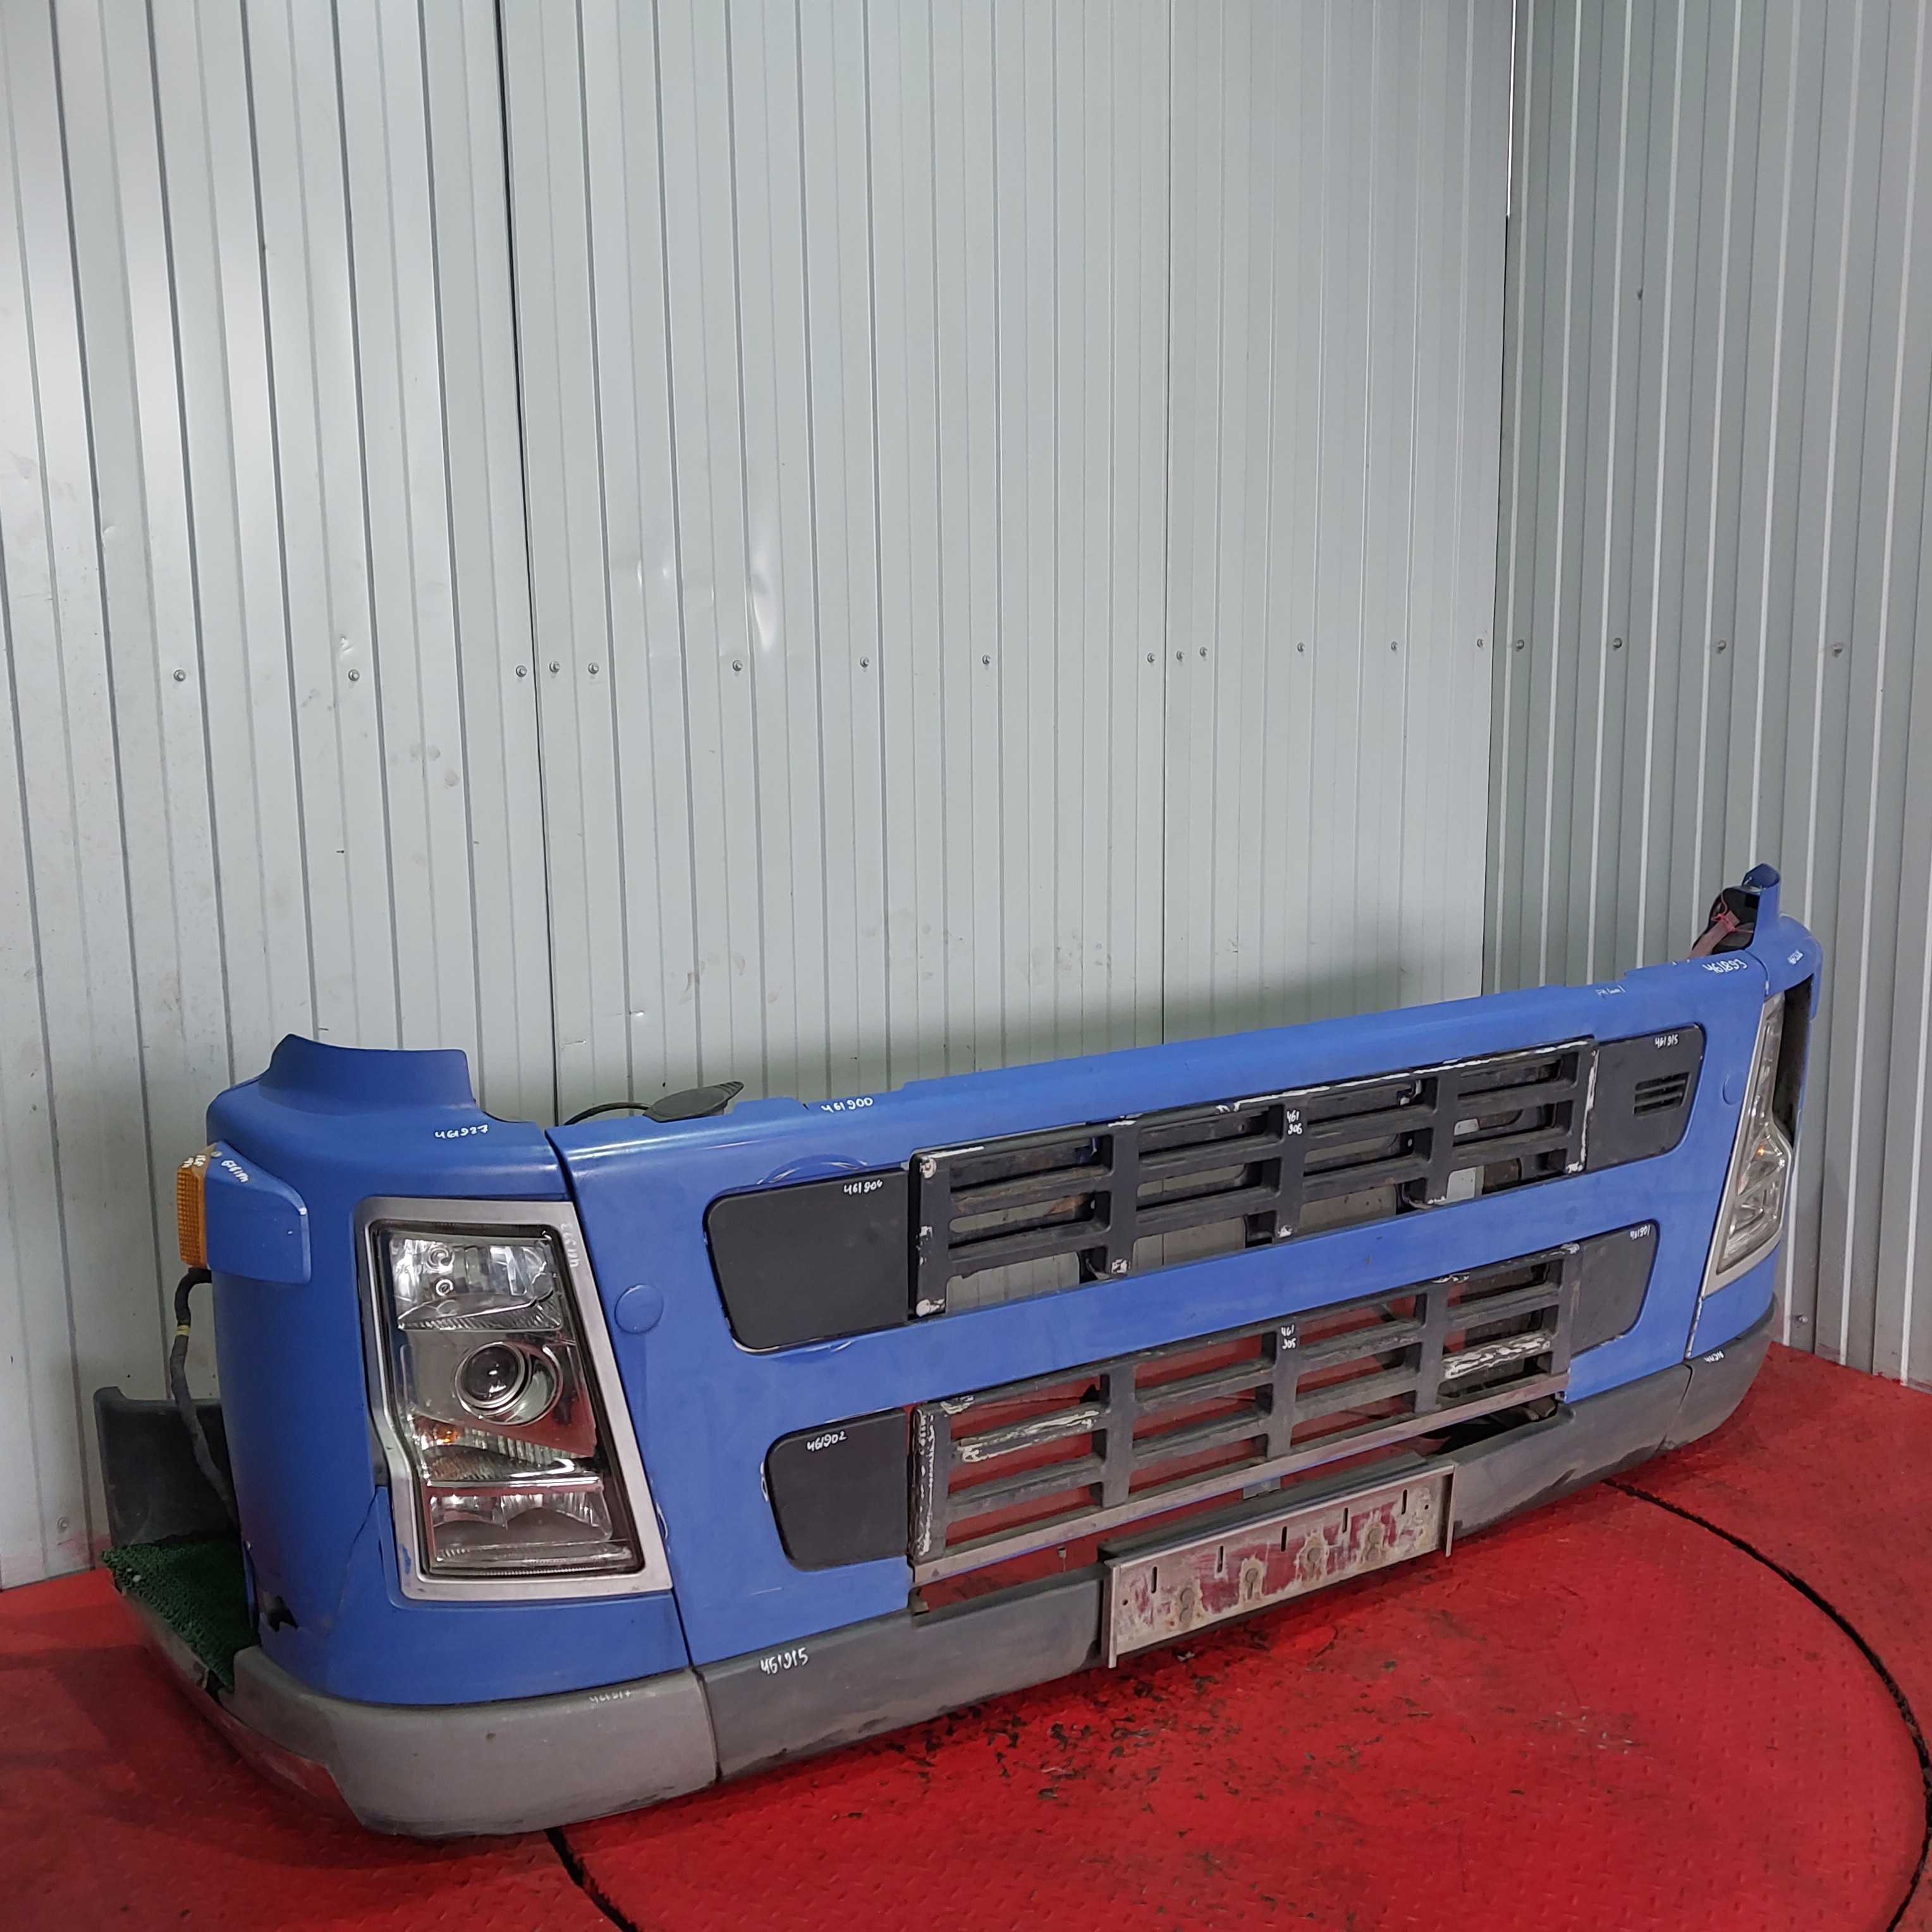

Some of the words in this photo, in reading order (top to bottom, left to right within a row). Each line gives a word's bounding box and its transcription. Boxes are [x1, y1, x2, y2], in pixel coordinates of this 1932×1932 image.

[1702, 958, 1747, 974] 461893
[821, 1097, 874, 1113] 461900
[1287, 1110, 1300, 1123] 461
[434, 1124, 489, 1139] 461927
[1288, 1122, 1302, 1135] 906
[1281, 1324, 1295, 1336] 461
[807, 1431, 847, 1452] 461902
[760, 1647, 809, 1675] 461915
